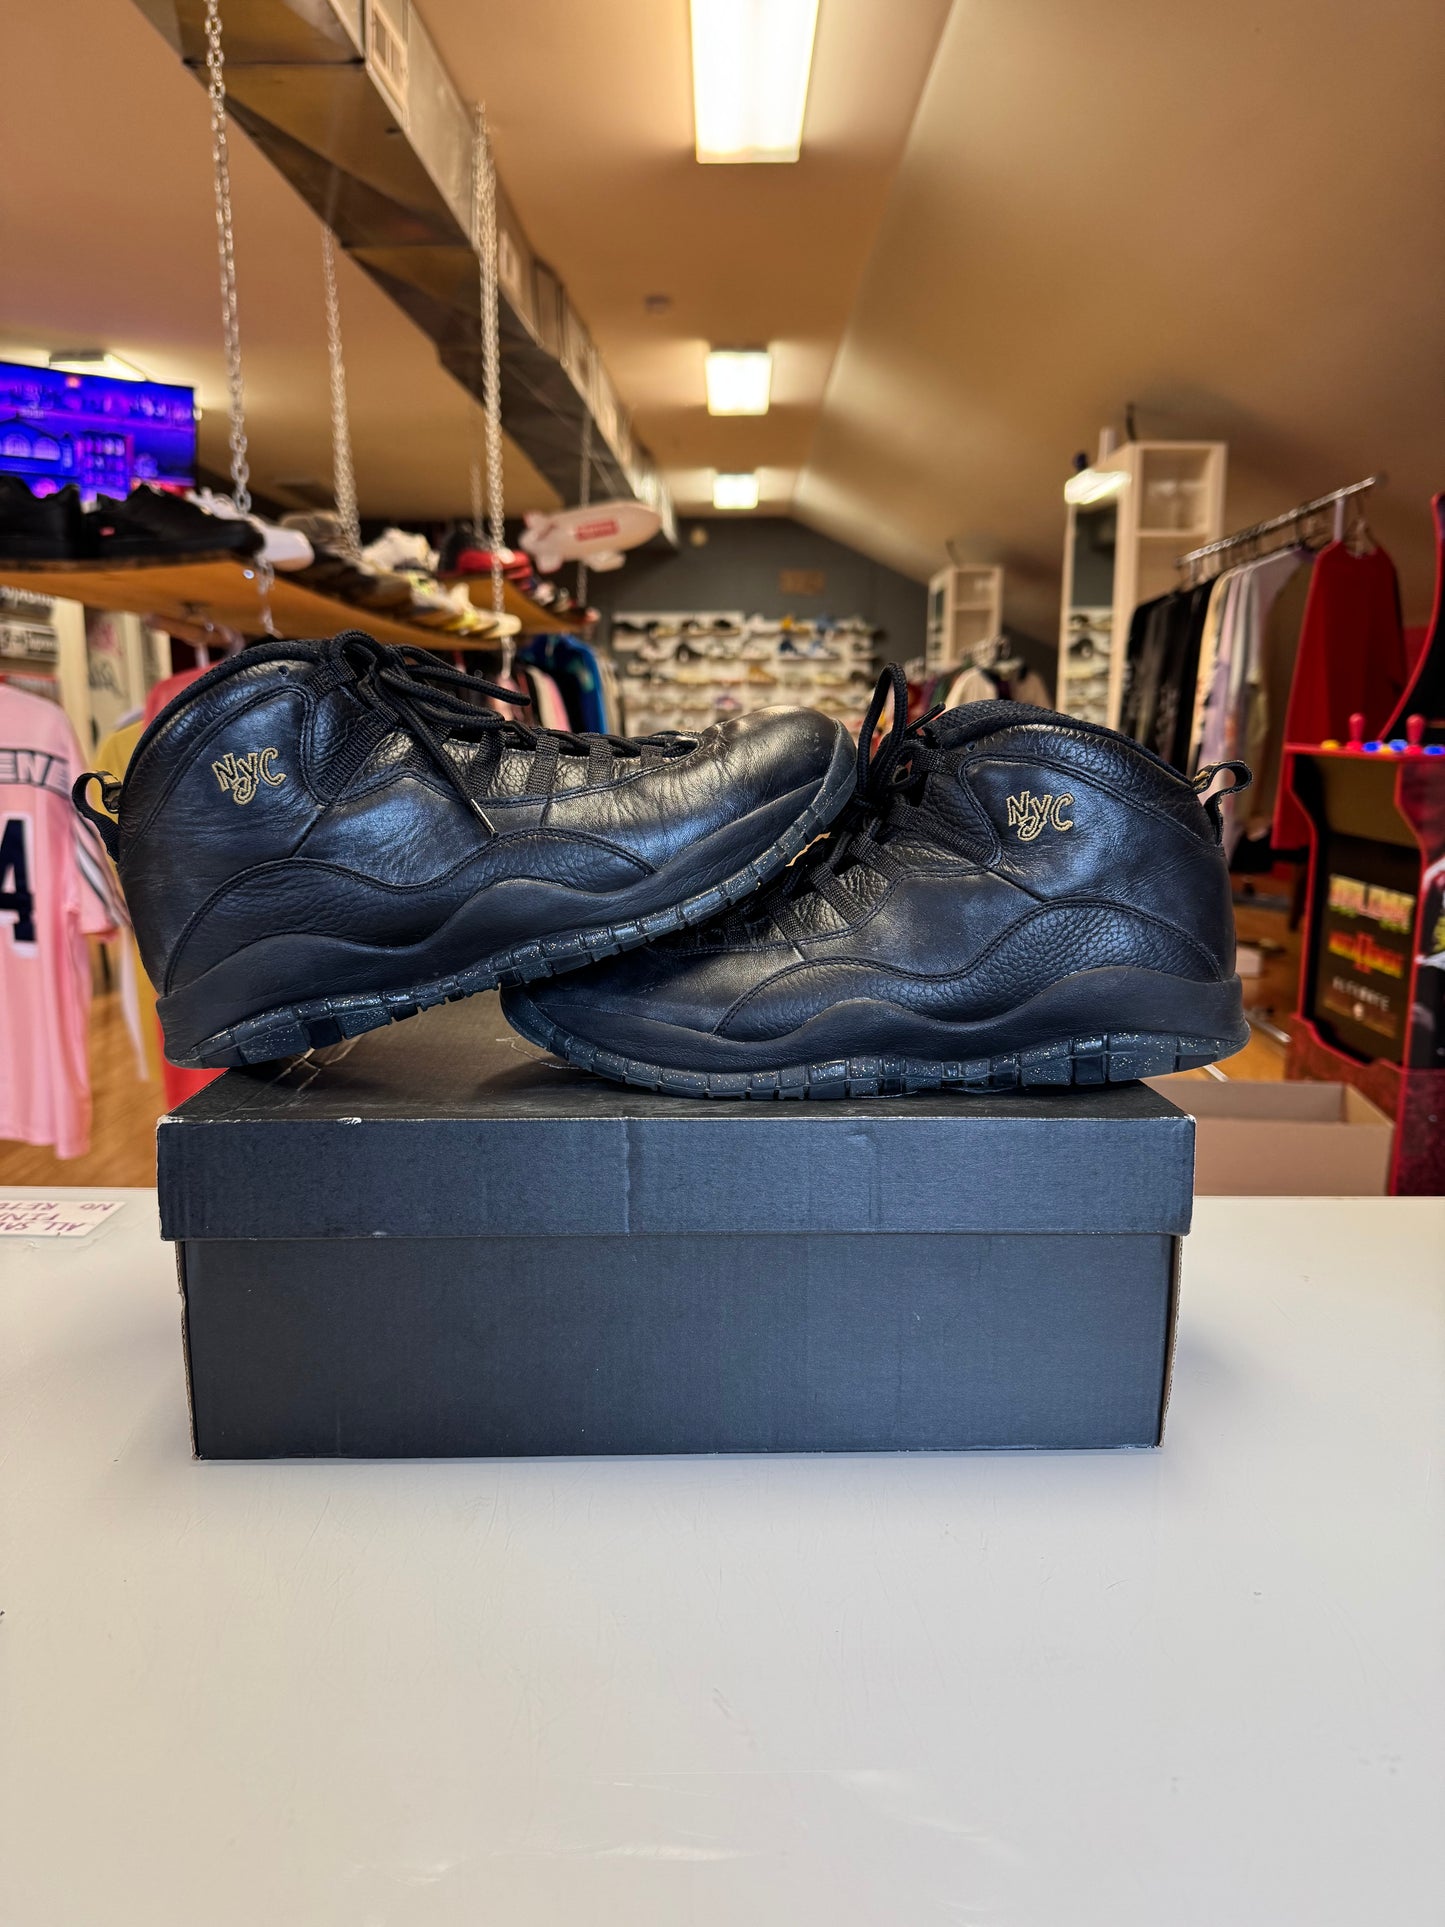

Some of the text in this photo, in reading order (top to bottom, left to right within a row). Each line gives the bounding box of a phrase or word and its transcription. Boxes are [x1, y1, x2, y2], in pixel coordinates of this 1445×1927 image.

[211, 747, 287, 806] NYC
[1005, 790, 1075, 842] NYC
[79, 1202, 115, 1211] NO
[44, 1221, 86, 1231] ALL
